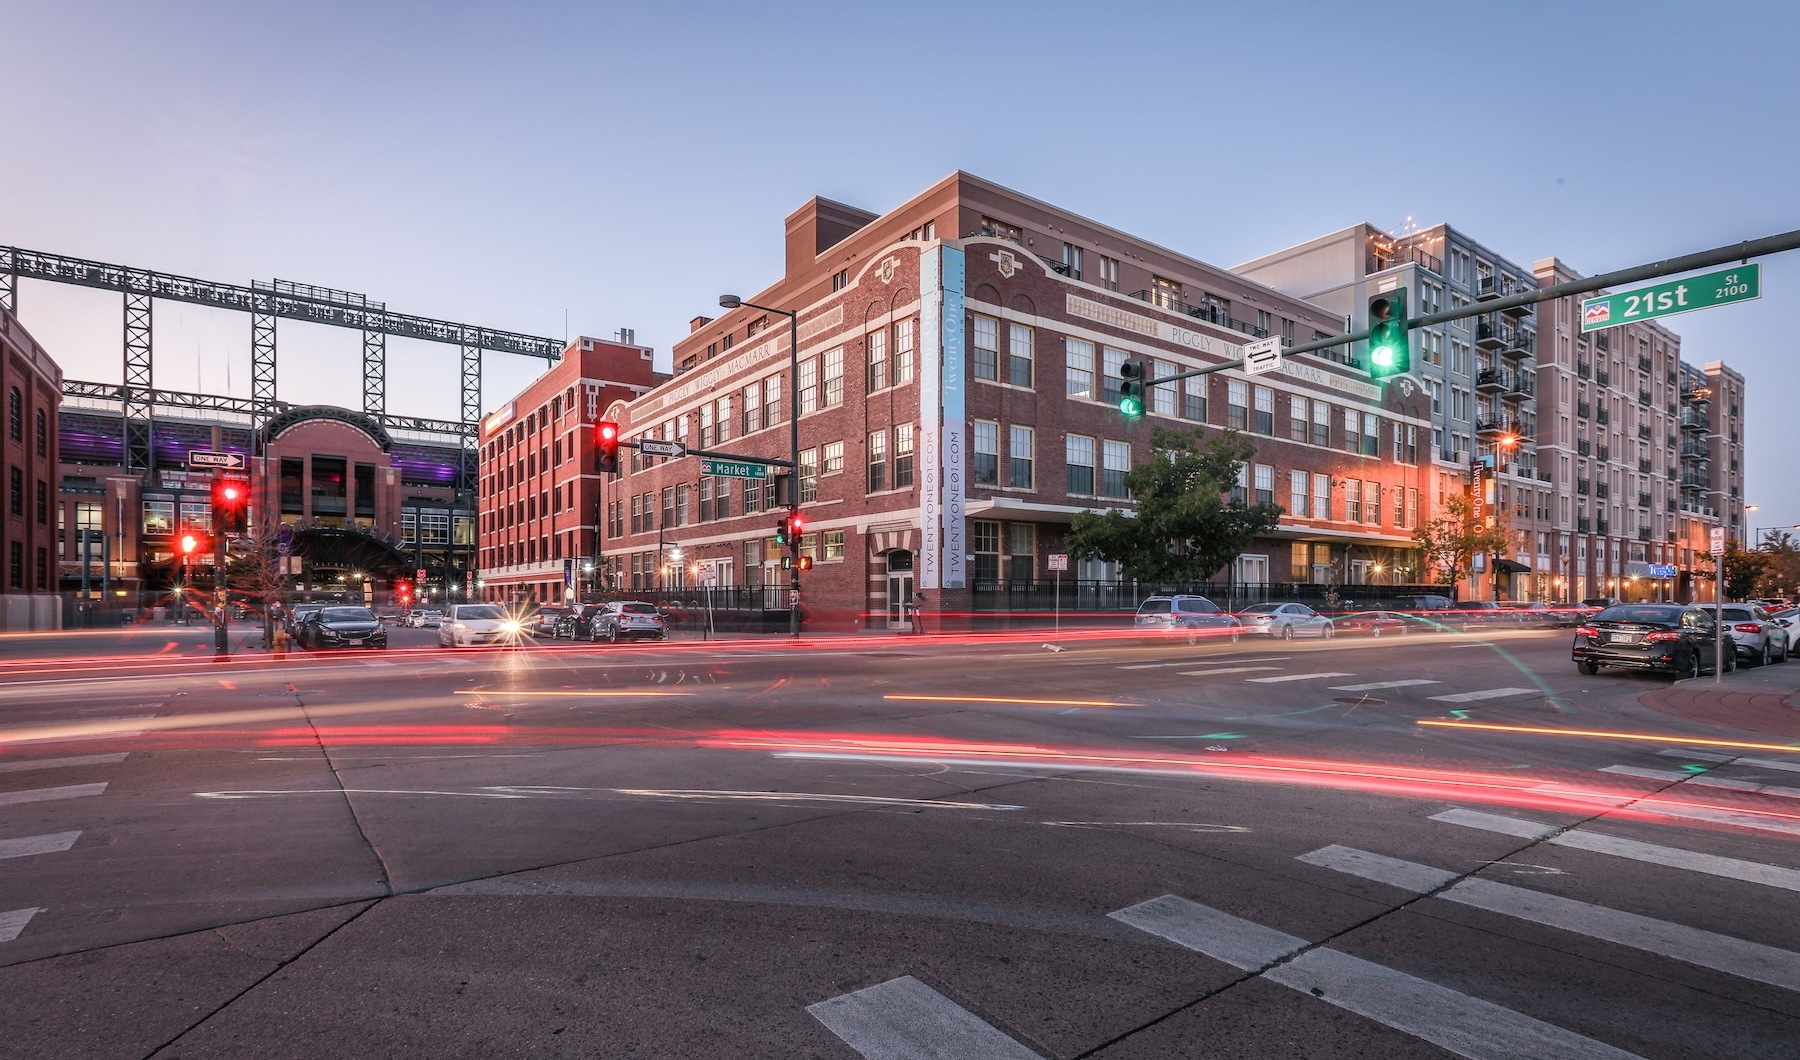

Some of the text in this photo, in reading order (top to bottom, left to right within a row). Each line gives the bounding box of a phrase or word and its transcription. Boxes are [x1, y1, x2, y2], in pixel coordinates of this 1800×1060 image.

[1725, 273, 1738, 286] St
[1716, 284, 1748, 299] 2100
[1623, 285, 1688, 318] 21st
[1585, 315, 1609, 324] DENVER
[1263, 340, 1274, 349] WAY
[1172, 327, 1213, 351] PIGGLY
[1279, 361, 1323, 382] ACMARR
[694, 369, 720, 392] WIGGLY
[727, 344, 770, 375] MACMARR
[1253, 362, 1274, 372] TRAFFIC
[716, 463, 749, 476] Market
